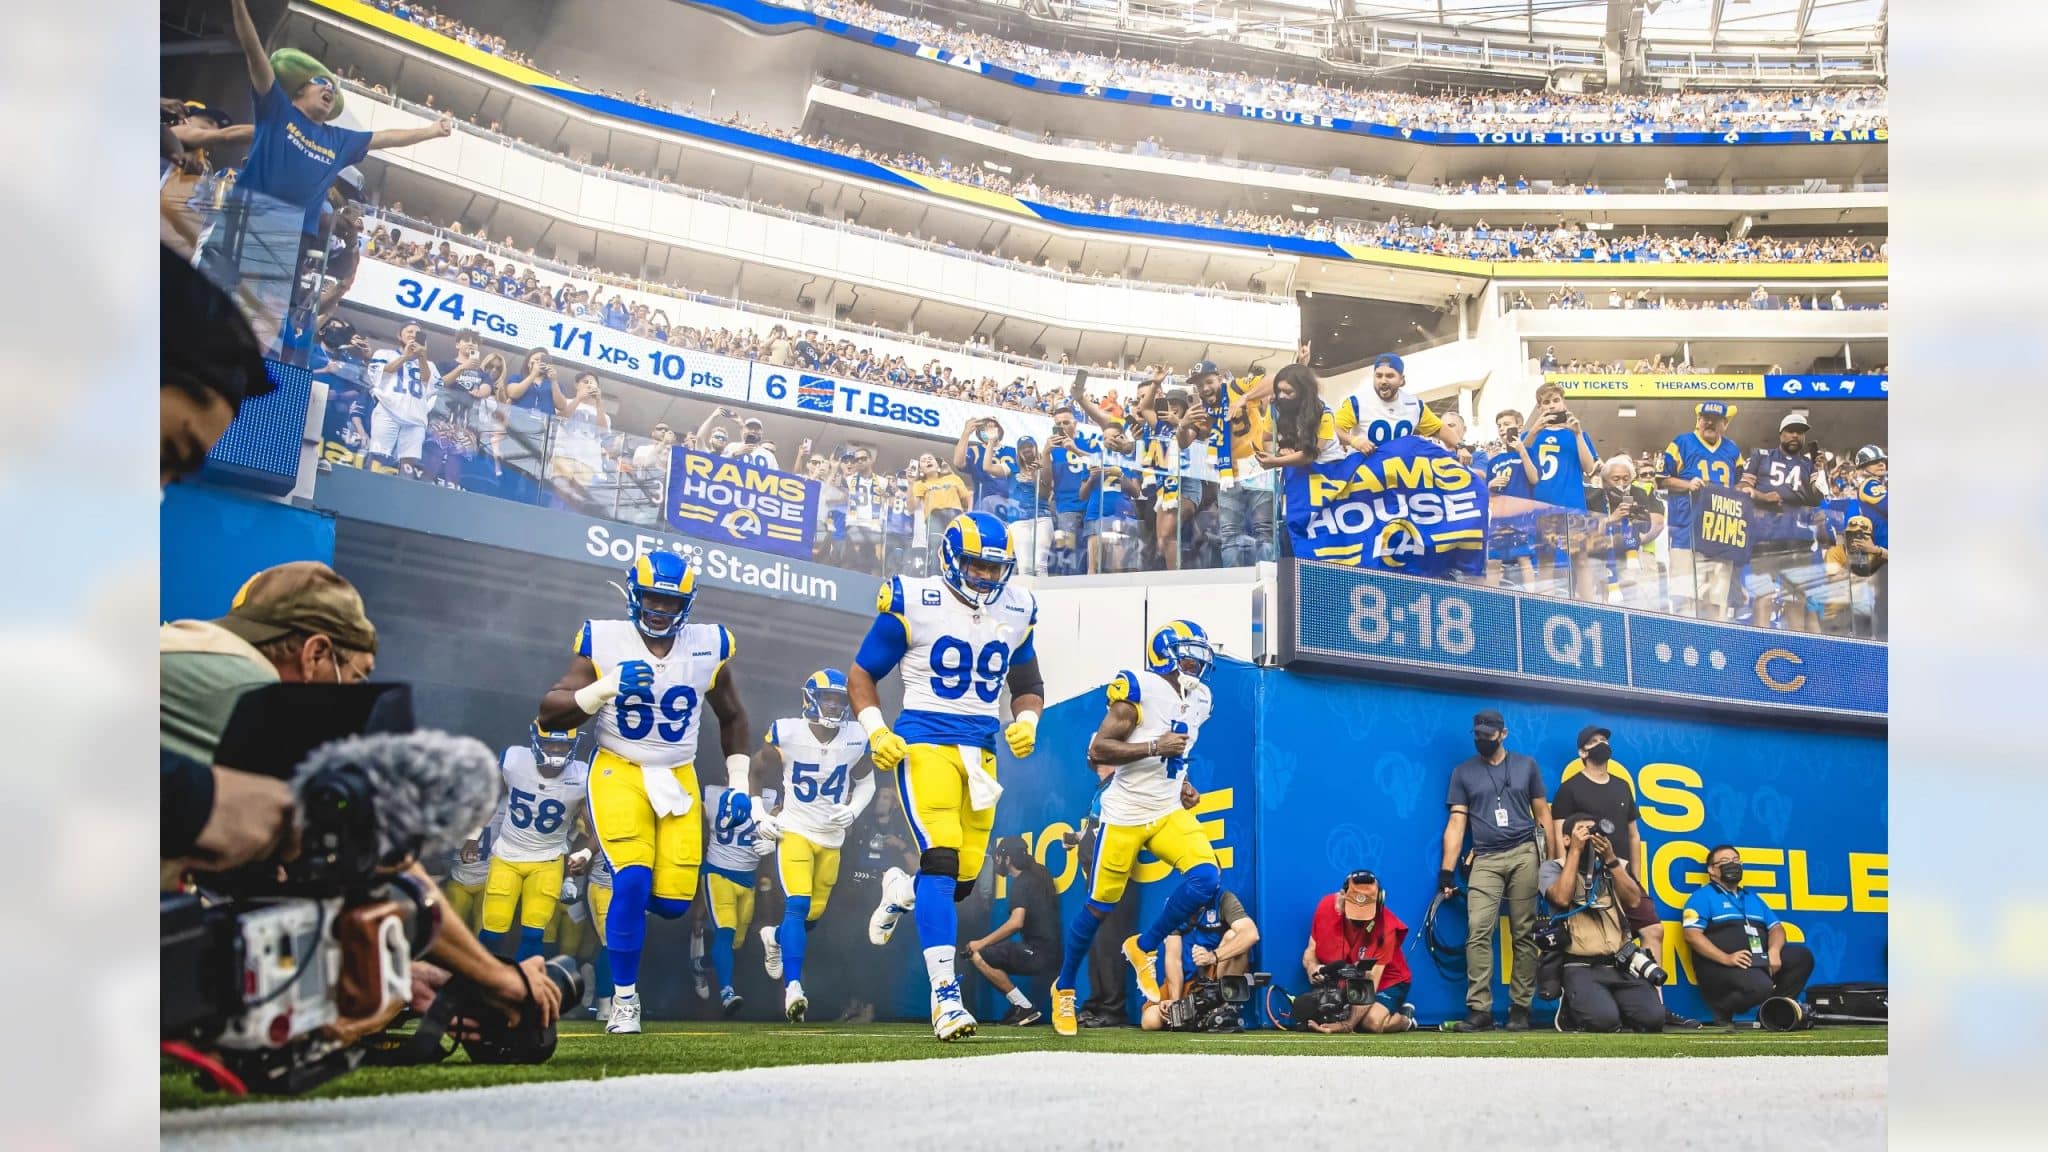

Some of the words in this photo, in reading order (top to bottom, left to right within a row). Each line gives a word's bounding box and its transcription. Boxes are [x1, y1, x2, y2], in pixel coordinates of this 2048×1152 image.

[1170, 97, 1227, 113] OUR
[1242, 106, 1334, 128] HOUSE
[1810, 128, 1888, 141] RAMS
[1474, 133, 1546, 143] YOUR
[1562, 133, 1655, 143] HOUSE
[395, 279, 465, 321] 3/4
[471, 309, 519, 337] FGs
[549, 323, 593, 356] 1/1
[597, 344, 640, 370] XPs
[649, 351, 686, 380] 10
[690, 371, 723, 388] pts
[393, 362, 423, 399] 18
[765, 374, 788, 400] 6
[839, 386, 940, 427] T.Bass
[1583, 381, 1629, 390] TICKETS
[1655, 381, 1754, 391] THERAMS.COM/TB
[685, 454, 806, 502] RAMS
[1309, 456, 1472, 507] RAMS
[1538, 444, 1561, 481] 5
[1697, 460, 1730, 488] 13
[1769, 461, 1802, 491] 54
[683, 477, 804, 522] HOUSE
[1307, 491, 1482, 539] HOUSE
[1711, 494, 1743, 516] VAMOS
[1702, 511, 1748, 548] RAMS
[707, 549, 837, 601] Stadium
[1347, 585, 1475, 655] 8:18
[1543, 614, 1604, 669] Q1
[929, 635, 1010, 704] 99
[1755, 649, 1806, 692] C
[615, 685, 698, 743] 69
[792, 760, 848, 804] 54
[509, 787, 566, 834] 58
[1637, 840, 1889, 913] GELE
